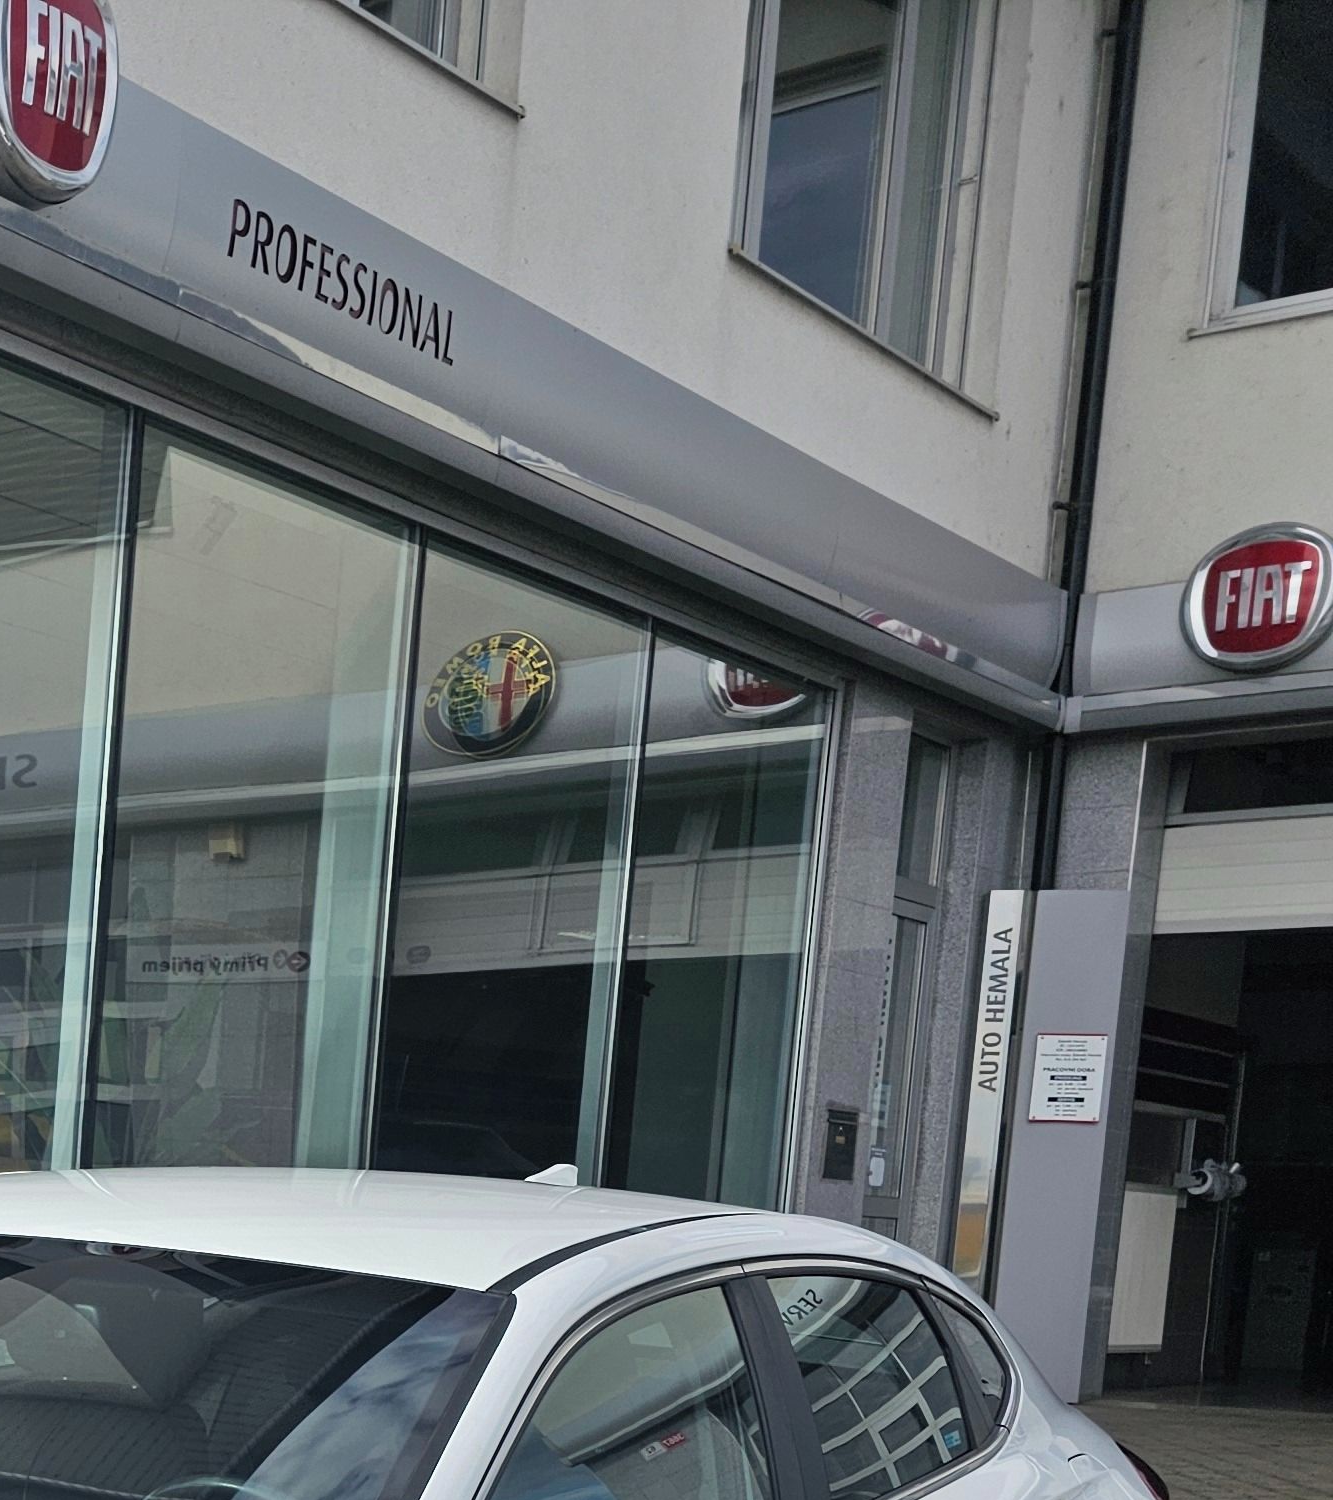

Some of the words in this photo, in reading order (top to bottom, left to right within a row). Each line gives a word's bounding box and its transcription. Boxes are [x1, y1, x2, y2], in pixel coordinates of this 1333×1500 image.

[21, 0, 103, 137] FIAT
[226, 198, 454, 366] PROFESSIONAL
[1215, 560, 1313, 632] FIAT
[985, 928, 1013, 1022] HEMALA
[978, 1032, 1002, 1093] AUTO
